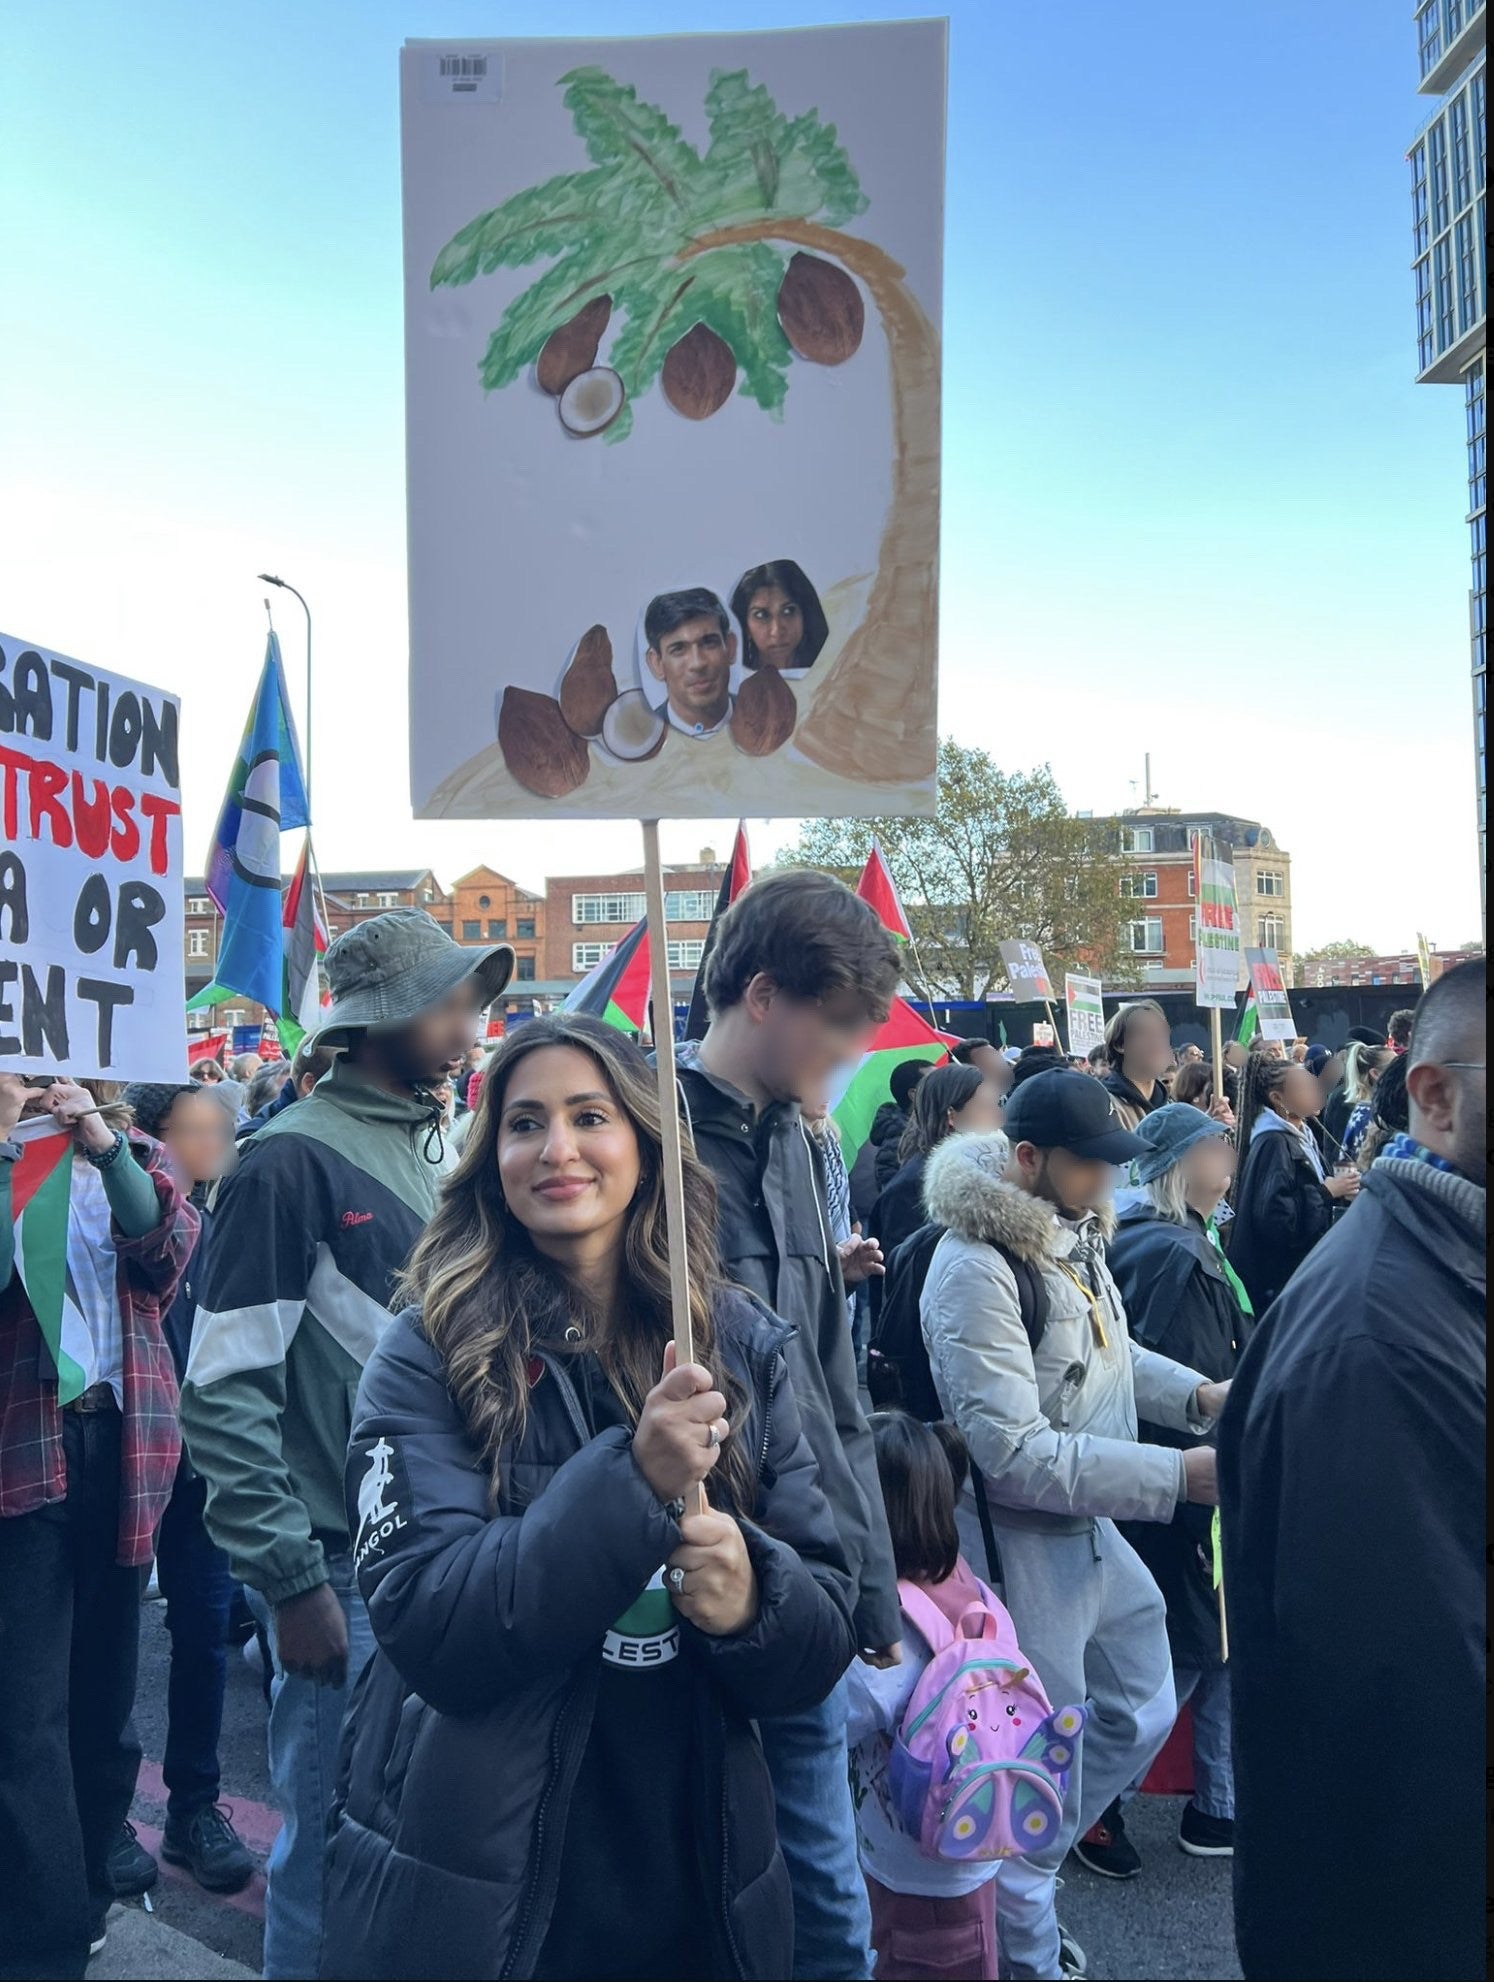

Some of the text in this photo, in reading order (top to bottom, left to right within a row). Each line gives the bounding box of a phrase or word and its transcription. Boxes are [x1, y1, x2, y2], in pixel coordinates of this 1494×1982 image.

[0, 745, 181, 876] TRUST
[73, 873, 167, 971] OR
[0, 959, 134, 1069] ENT
[1070, 1009, 1104, 1033] FREE
